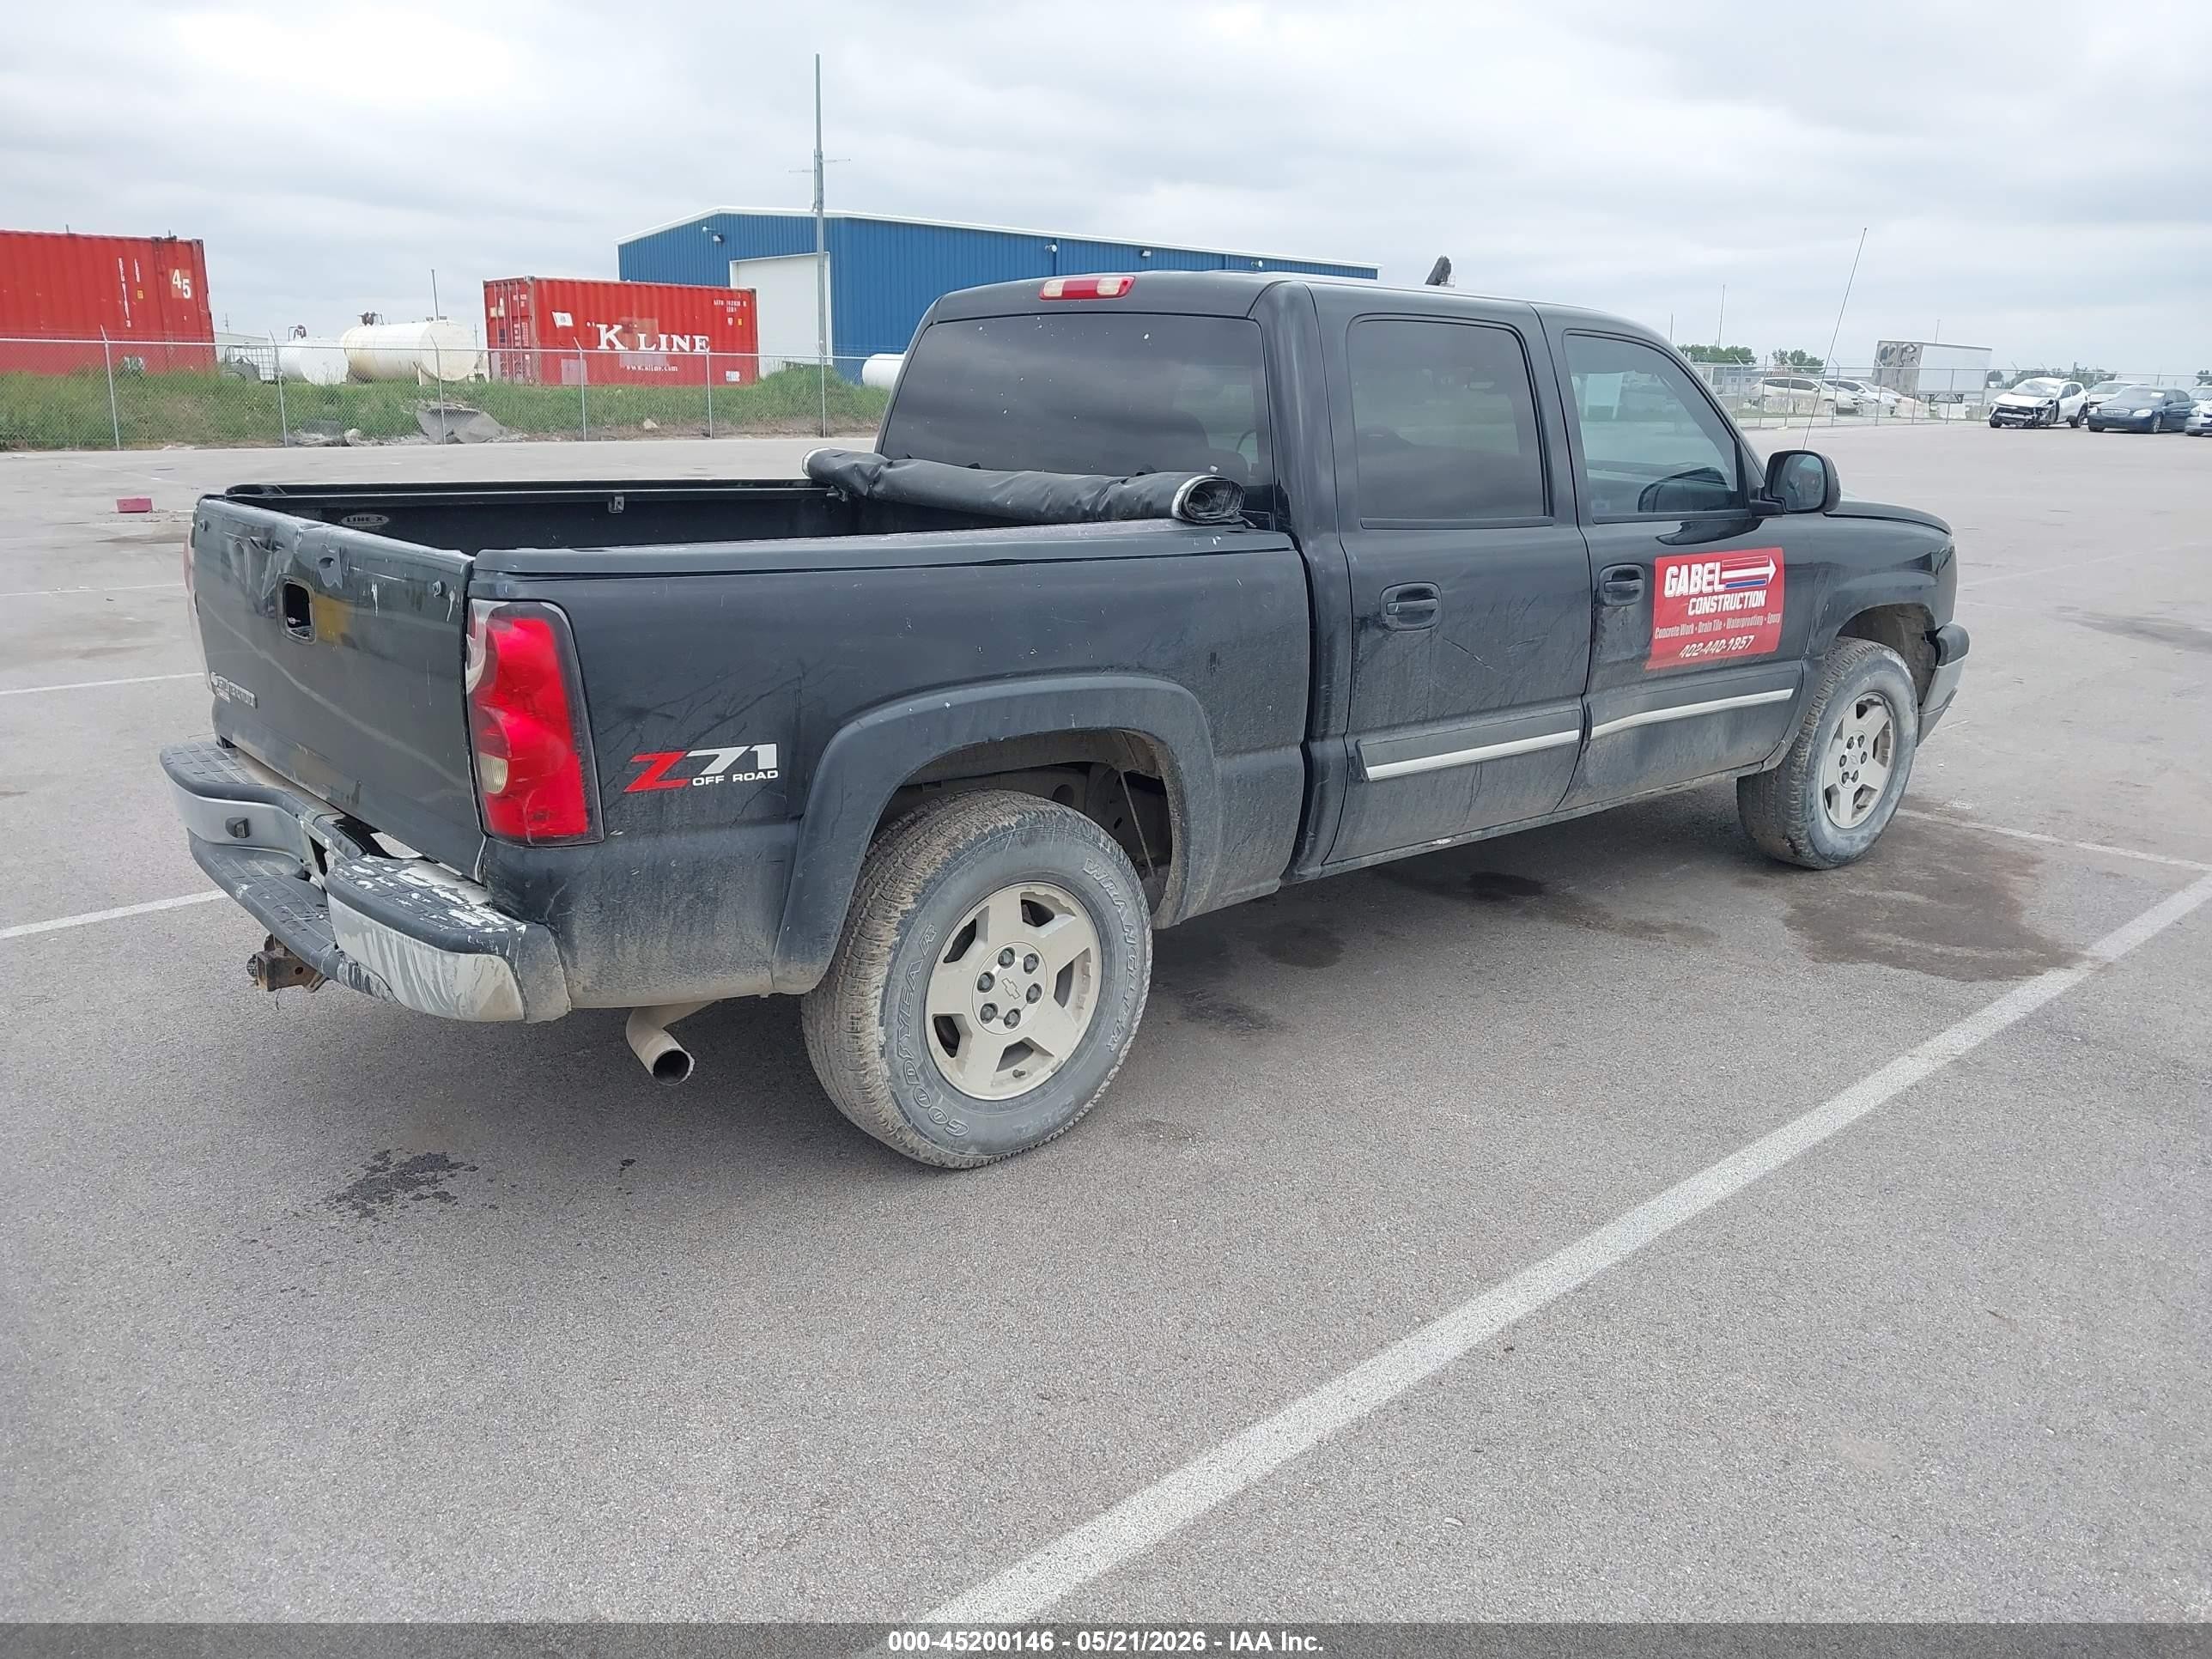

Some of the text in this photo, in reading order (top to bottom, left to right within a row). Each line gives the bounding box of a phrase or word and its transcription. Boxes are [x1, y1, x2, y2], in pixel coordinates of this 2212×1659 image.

[172, 269, 191, 299] 45
[637, 332, 711, 353] LINE
[1663, 562, 1726, 598] GABEL
[1687, 590, 1767, 616] CONSTRUCTION
[1655, 626, 1680, 640] Concrete
[1679, 635, 1755, 659] 402-440-1857
[623, 743, 777, 793] Z71
[692, 770, 779, 787] OFF ROAD
[1083, 858, 1140, 1054] WRANGLER
[895, 924, 971, 1136] GOODYEAR
